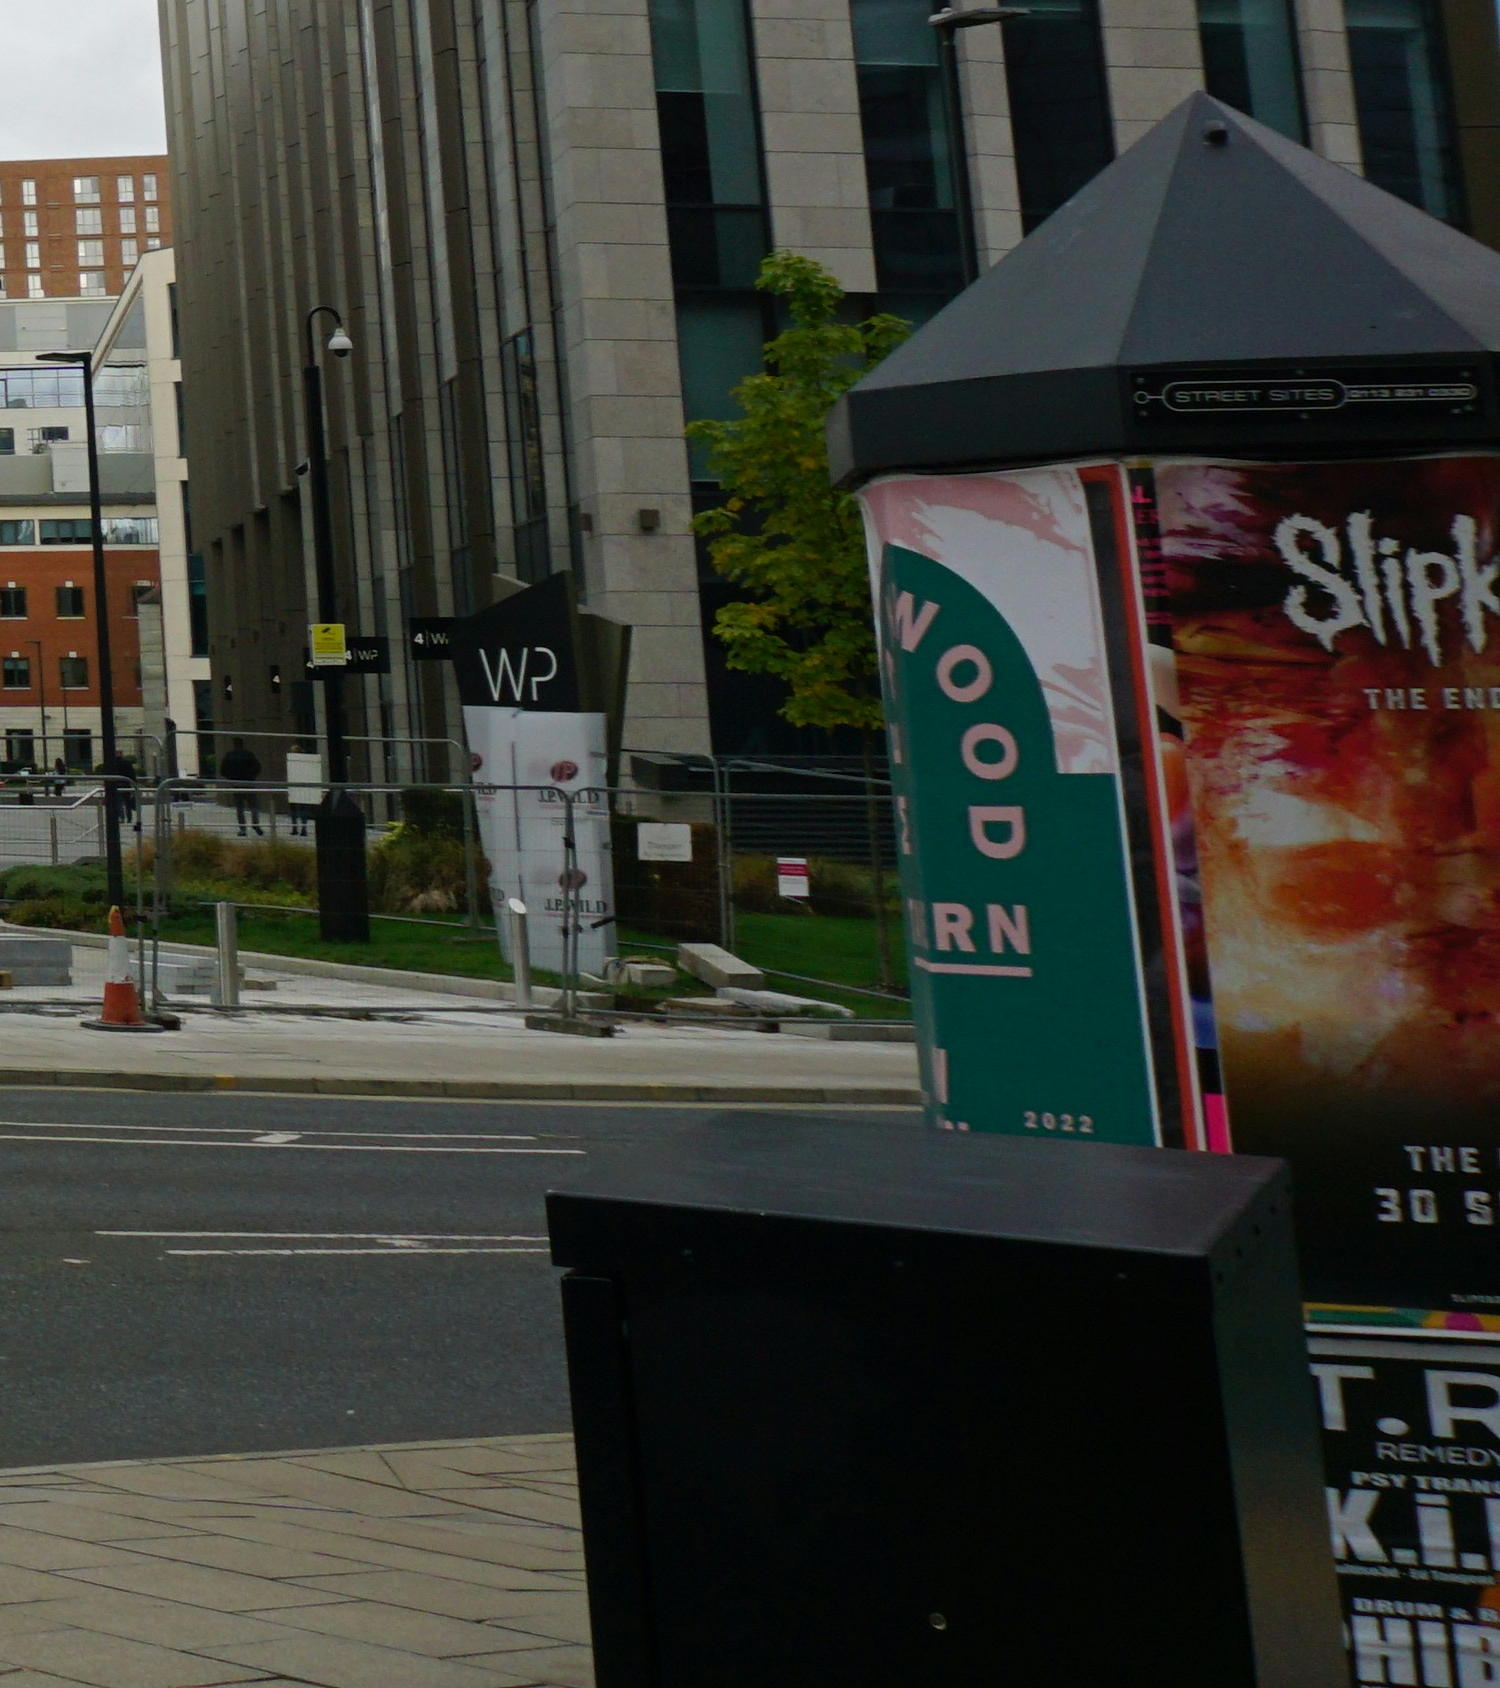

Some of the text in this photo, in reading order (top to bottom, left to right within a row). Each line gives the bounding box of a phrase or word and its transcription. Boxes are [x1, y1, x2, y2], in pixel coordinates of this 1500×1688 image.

[1175, 389, 1260, 404] STREET
[1269, 387, 1336, 403] SITES
[1363, 687, 1429, 710] THE
[1023, 1111, 1096, 1135] 2022
[1402, 1144, 1483, 1174] THE
[1373, 1187, 1500, 1226] 30 S
[1352, 1596, 1444, 1618] DRUM
